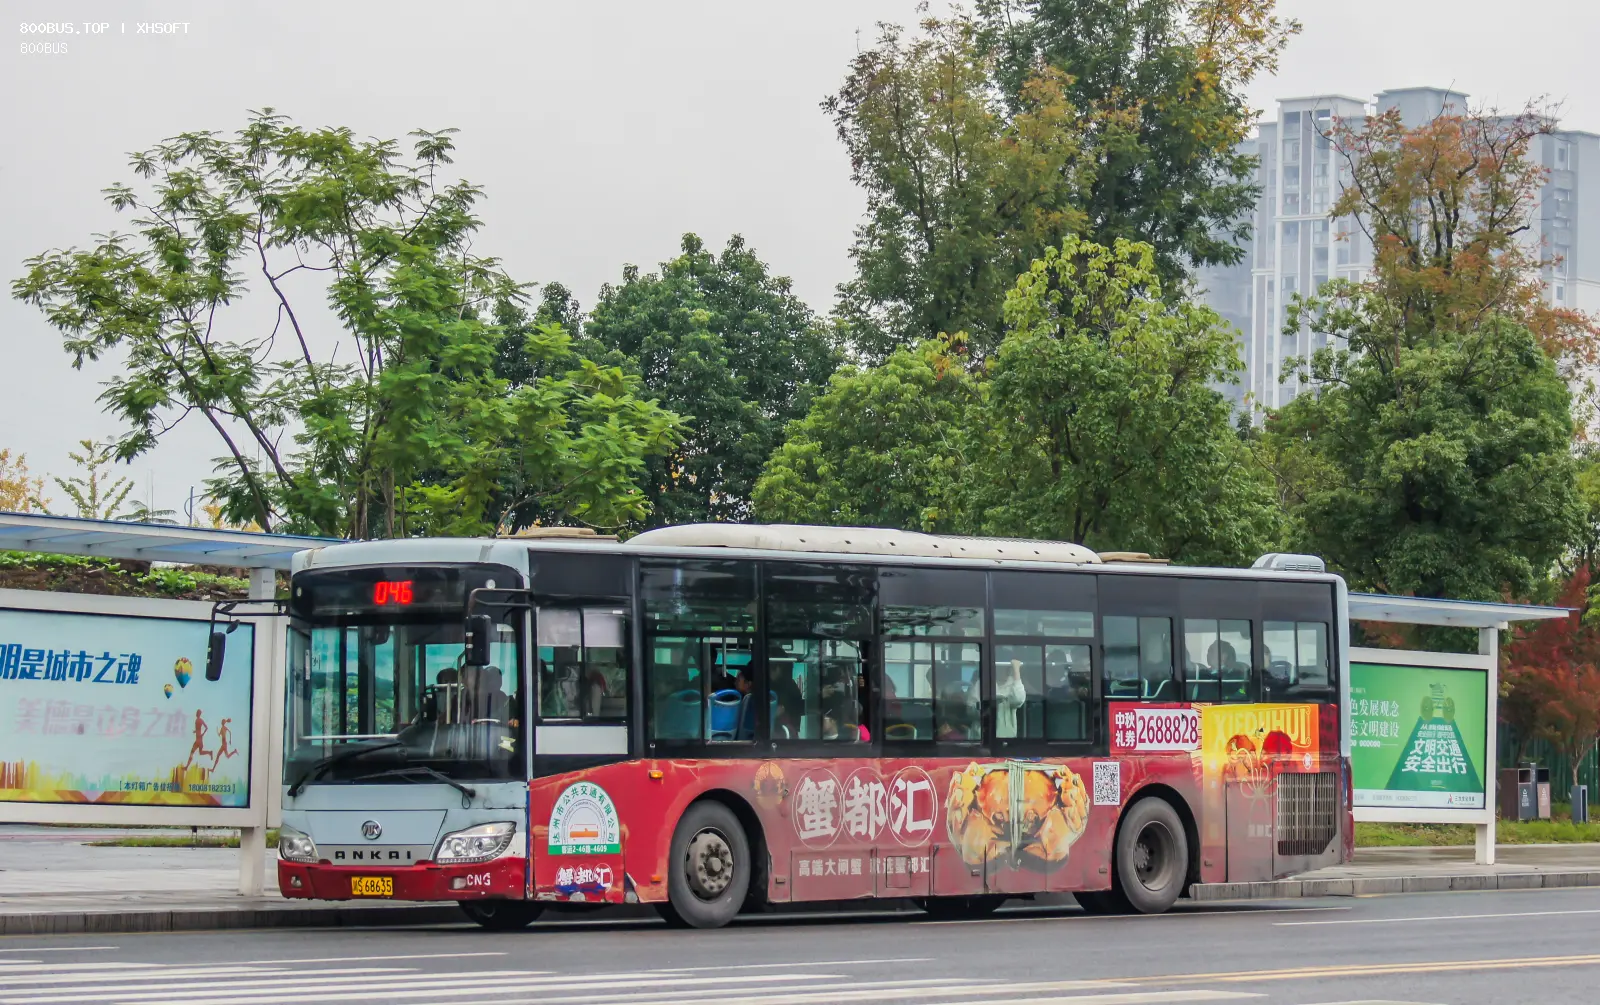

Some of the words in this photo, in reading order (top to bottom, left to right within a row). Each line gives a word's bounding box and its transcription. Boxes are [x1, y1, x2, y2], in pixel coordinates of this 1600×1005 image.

[373, 580, 414, 605] 046
[0, 643, 142, 685] 明是城市之魂
[1115, 711, 1136, 729] 中秋
[1138, 715, 1198, 744] 2688828
[1115, 730, 1136, 747] 礼券
[1409, 739, 1463, 757] 文明交通
[1402, 756, 1467, 774] 安全出行
[553, 785, 615, 844] 达州市公共交通有限公司
[797, 776, 934, 841] 蟹都汇
[335, 850, 412, 860] ANKAI
[798, 858, 862, 876] 高端大闸蟹
[466, 872, 491, 886] CNG
